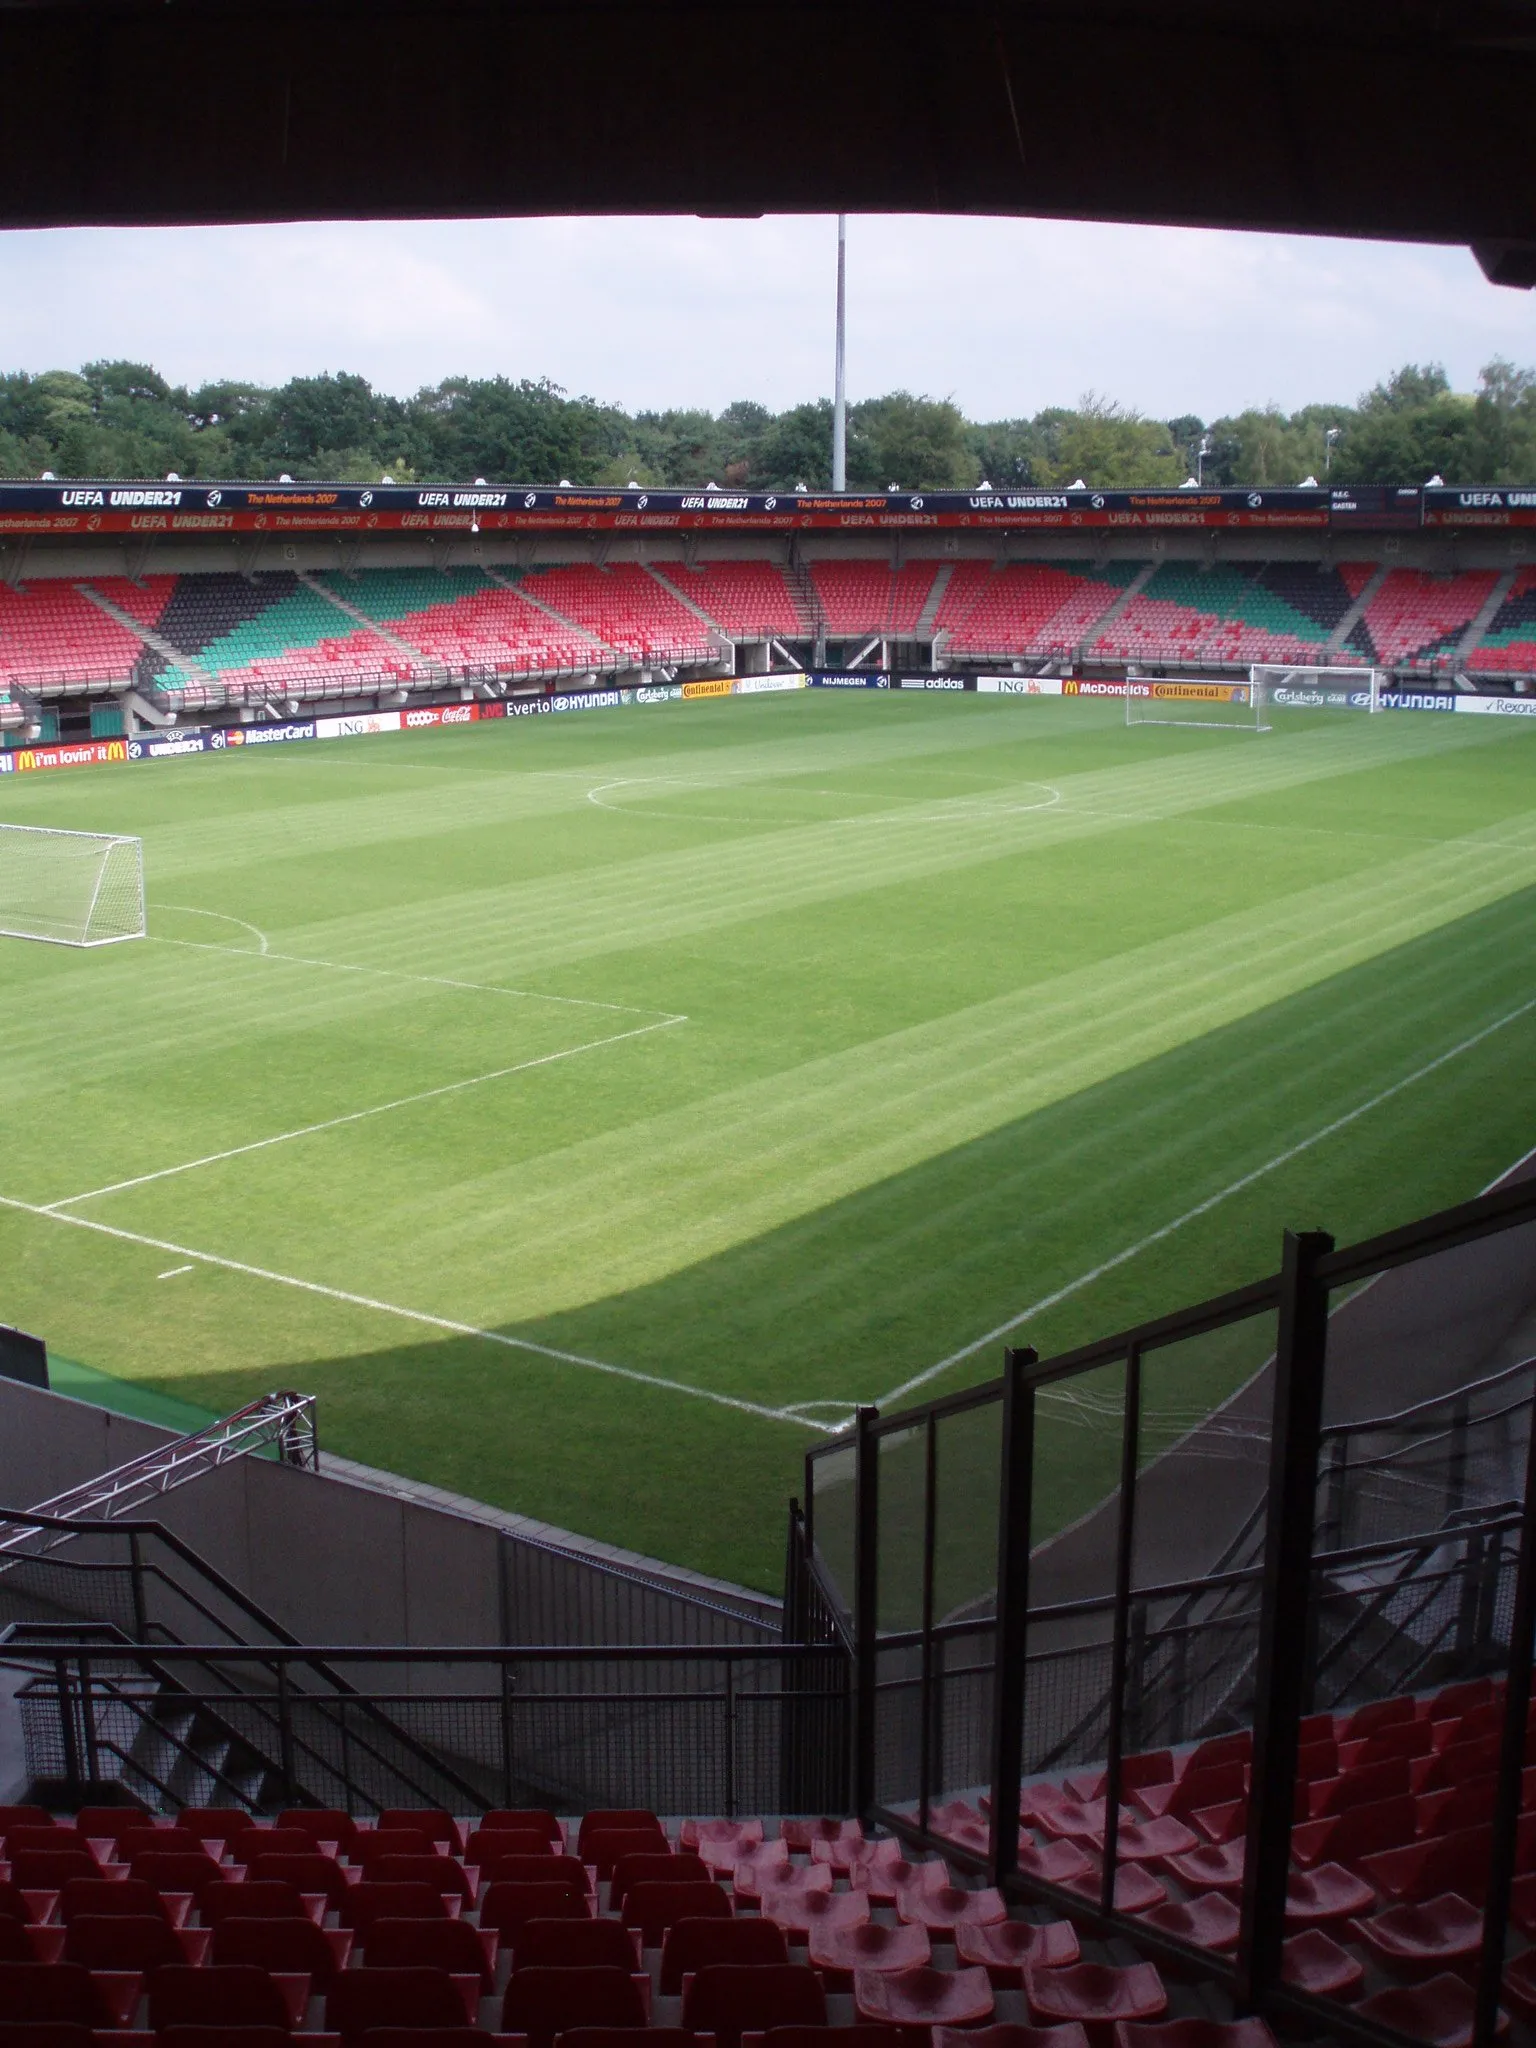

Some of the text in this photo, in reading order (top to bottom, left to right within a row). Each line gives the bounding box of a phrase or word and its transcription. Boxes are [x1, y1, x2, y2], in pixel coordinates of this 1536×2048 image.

[62, 492, 182, 505] UEFA UNDER21
[248, 494, 338, 504] The Netherlands 2007
[418, 493, 507, 506] UEFA UNDER21
[555, 496, 622, 506] The Netherlands 2007
[681, 496, 749, 509] UEFA UNDER21
[797, 499, 887, 508] The Netherlands 2007
[970, 496, 1068, 508] UEFA UNDER21
[1130, 496, 1221, 505] The Netherlands 2007
[1460, 493, 1502, 506] UEFA
[53, 517, 80, 528] 2007
[131, 515, 234, 528] UEFA UNDER21
[276, 516, 361, 526] The Netherlands 2007
[402, 515, 482, 526] UEFA UNDER21
[614, 515, 680, 526] UEFA UNDER21
[712, 516, 793, 525] The Netherlands 2007
[840, 514, 938, 525] UEFA UNDER21
[979, 515, 1063, 524] The Netherlands 2007
[1108, 513, 1205, 524] UEFA UNDER21
[823, 677, 867, 686] NIJMEGEN
[925, 678, 964, 689] adidas
[998, 681, 1024, 692] ING
[636, 687, 669, 703] Carlsberg
[683, 681, 724, 697] Continental
[1080, 682, 1150, 696] McDonald's
[1155, 685, 1219, 698] Continental
[569, 691, 619, 709] HYUNDAI
[1274, 688, 1324, 705] Carlsberg
[1377, 693, 1453, 710] HYUNDAI
[482, 702, 504, 719] JVC
[507, 699, 550, 717] Everio
[245, 722, 314, 745] MasterCard
[338, 719, 364, 737] ING
[149, 738, 204, 757] UNDER21
[36, 746, 107, 767] i'm lovin' it
